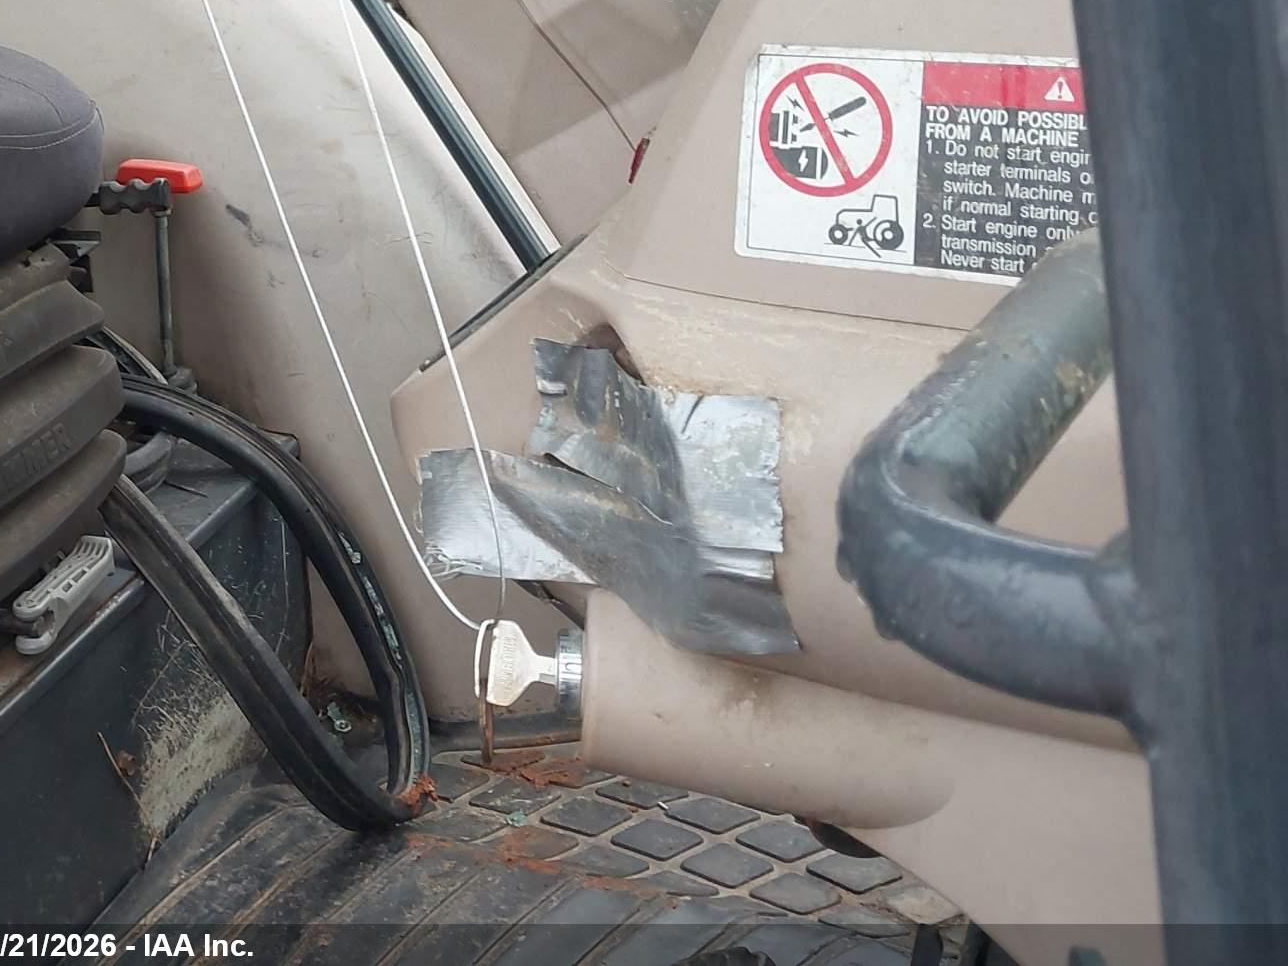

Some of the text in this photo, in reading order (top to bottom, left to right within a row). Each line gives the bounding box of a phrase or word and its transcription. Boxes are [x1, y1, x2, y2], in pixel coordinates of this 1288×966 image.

[926, 106, 949, 123] TO
[958, 108, 1008, 126] AVOID
[925, 123, 1079, 147] FROM A MACHINE
[926, 140, 940, 155] 1.
[945, 141, 966, 156] Do
[974, 144, 999, 159] not
[1007, 146, 1041, 162] start
[944, 160, 992, 177] starter
[1000, 163, 1071, 183] terminals
[943, 180, 996, 197] switch.
[1005, 183, 1073, 203] Machine
[942, 196, 953, 212] if
[960, 199, 1012, 216] normal
[1019, 207, 1080, 225] starting
[922, 213, 937, 228] 2.
[941, 214, 977, 232] Start
[985, 222, 1038, 239] engine
[941, 234, 1037, 258] transmission
[940, 251, 984, 269] Never
[991, 257, 1025, 274] start
